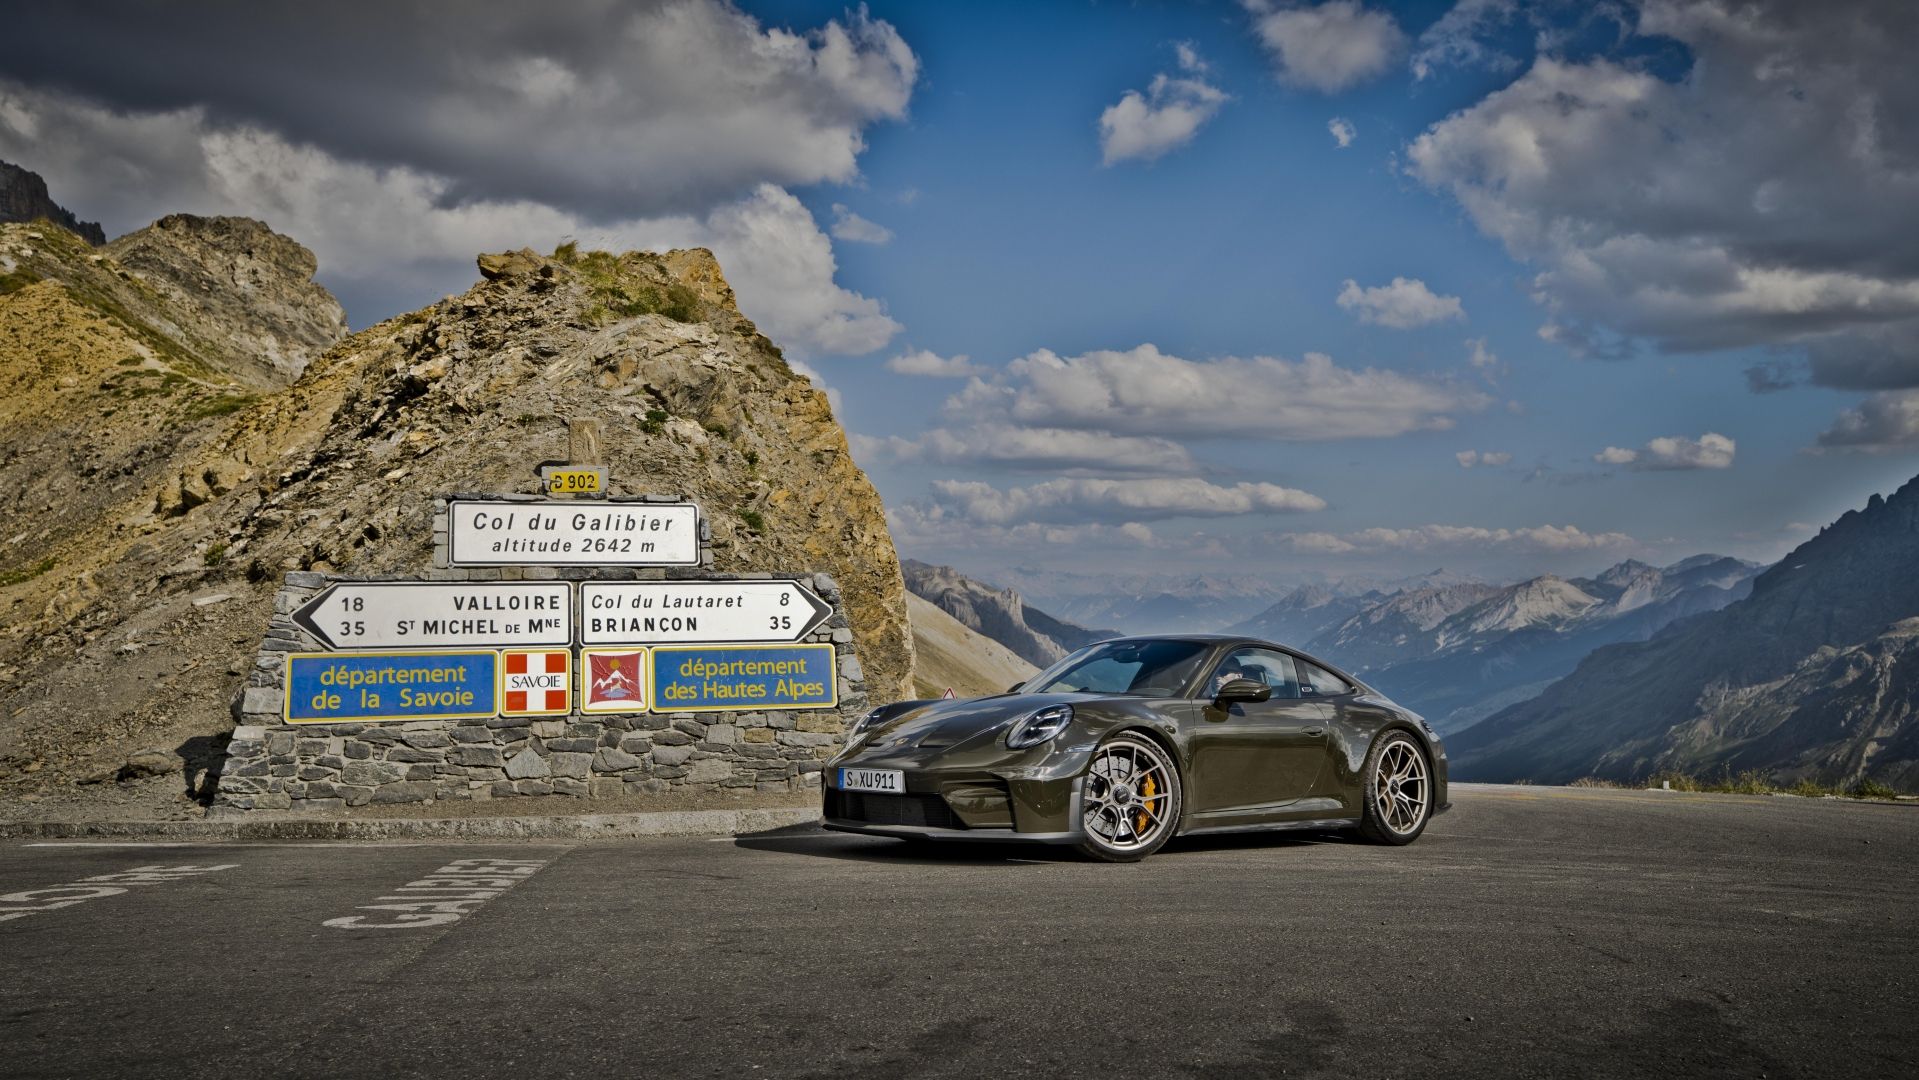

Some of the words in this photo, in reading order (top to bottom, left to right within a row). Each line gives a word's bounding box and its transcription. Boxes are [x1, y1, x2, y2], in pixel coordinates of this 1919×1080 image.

[568, 474, 596, 489] 902
[473, 512, 514, 531] Col
[528, 513, 557, 531] du
[571, 513, 673, 532] Galibier
[491, 538, 572, 553] altitude
[581, 538, 632, 553] 2642
[640, 542, 655, 553] m
[341, 597, 364, 612] 18
[454, 595, 560, 611] VALLOIRE
[592, 594, 622, 609] Col
[631, 594, 652, 609] du
[663, 594, 743, 609] Lautaret
[779, 592, 790, 607] 8
[340, 621, 365, 637] 35
[423, 619, 499, 635] MICHEL
[505, 623, 521, 634] DE
[591, 617, 697, 633] BRIANÇON
[769, 616, 792, 631] 35
[320, 665, 467, 689] département
[680, 658, 808, 680] département
[511, 675, 561, 689] SAVOIE
[664, 681, 698, 700] des
[703, 680, 767, 699] Hautes
[775, 678, 825, 701] Alpes
[311, 689, 342, 711] de
[361, 688, 381, 709] la
[399, 687, 475, 708] Savoie
[847, 771, 853, 787] S
[322, 858, 548, 929] GALIBIER
